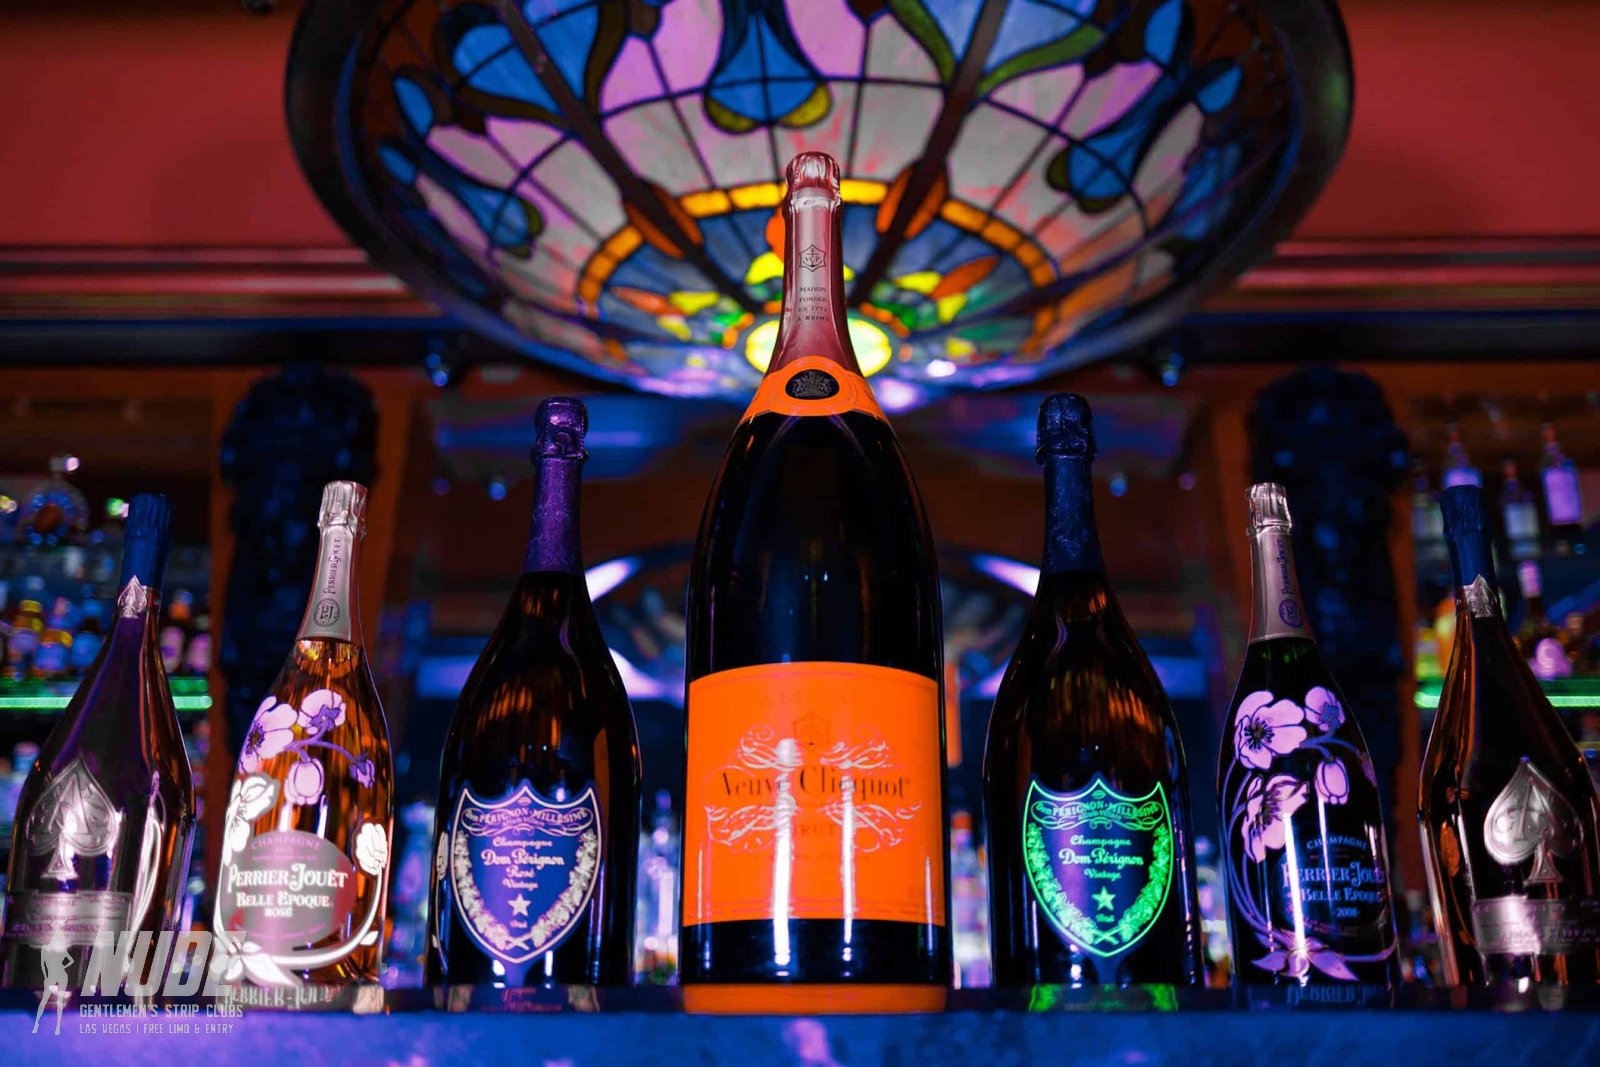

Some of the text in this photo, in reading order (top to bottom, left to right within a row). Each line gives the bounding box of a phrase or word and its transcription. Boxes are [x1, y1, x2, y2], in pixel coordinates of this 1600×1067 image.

[251, 835, 321, 850] CHAMPAGNE
[492, 836, 553, 850] Champagne
[1070, 835, 1132, 848] Champagne
[1306, 836, 1368, 850] CHMPAGNE
[481, 848, 565, 870] Dom Pérignon
[1058, 848, 1144, 870] Dom Pérignon
[1084, 868, 1121, 881] Vintage
[502, 879, 538, 891] Vintage
[236, 891, 274, 907] BELLE
[1301, 887, 1341, 901] BELLE
